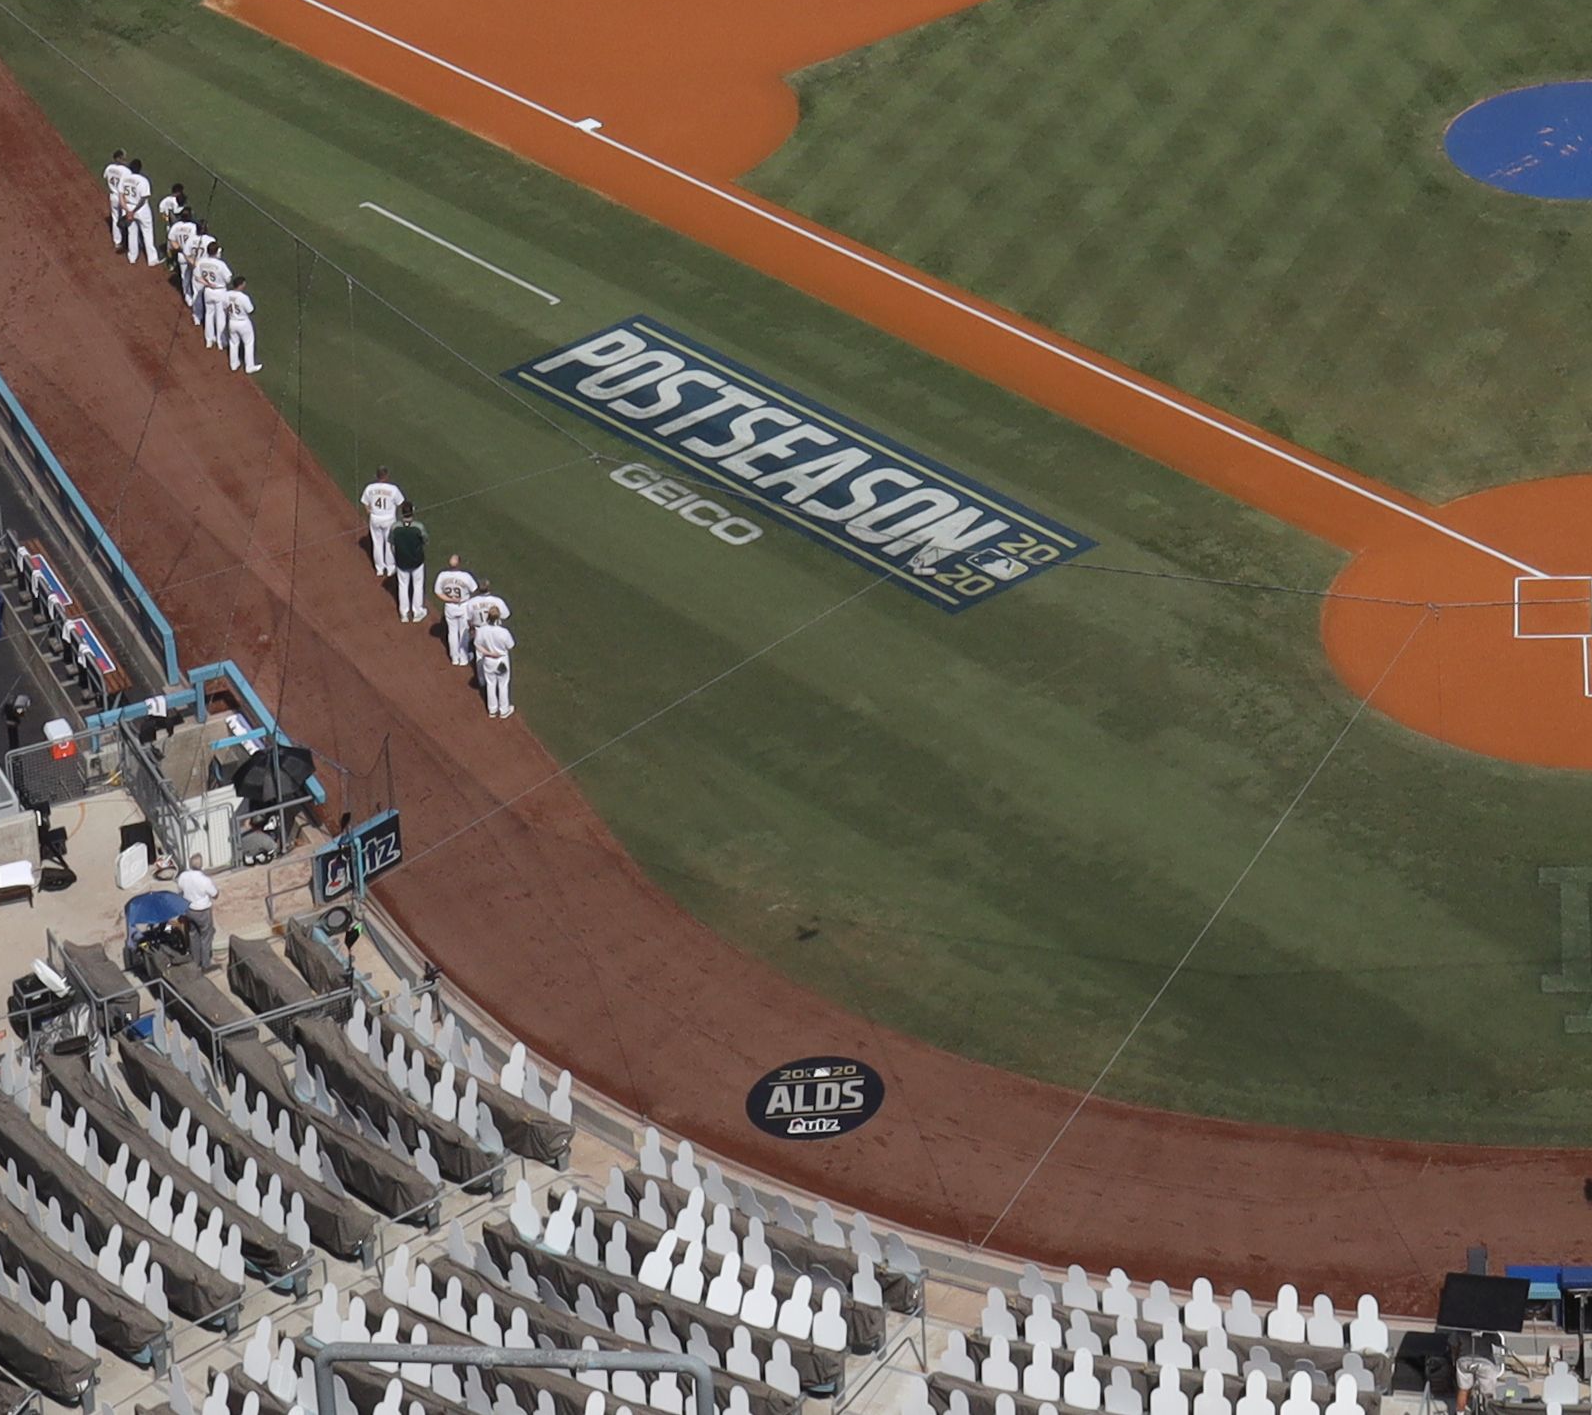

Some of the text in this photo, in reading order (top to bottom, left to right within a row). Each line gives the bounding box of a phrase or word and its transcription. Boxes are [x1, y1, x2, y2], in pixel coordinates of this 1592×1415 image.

[532, 328, 1010, 559] POSTSEASON
[375, 497, 387, 510] 41
[609, 463, 764, 545] GEICO
[933, 533, 1061, 597] 20 20
[765, 1079, 864, 1115] ALDS
[779, 1065, 857, 1081] 20 20
